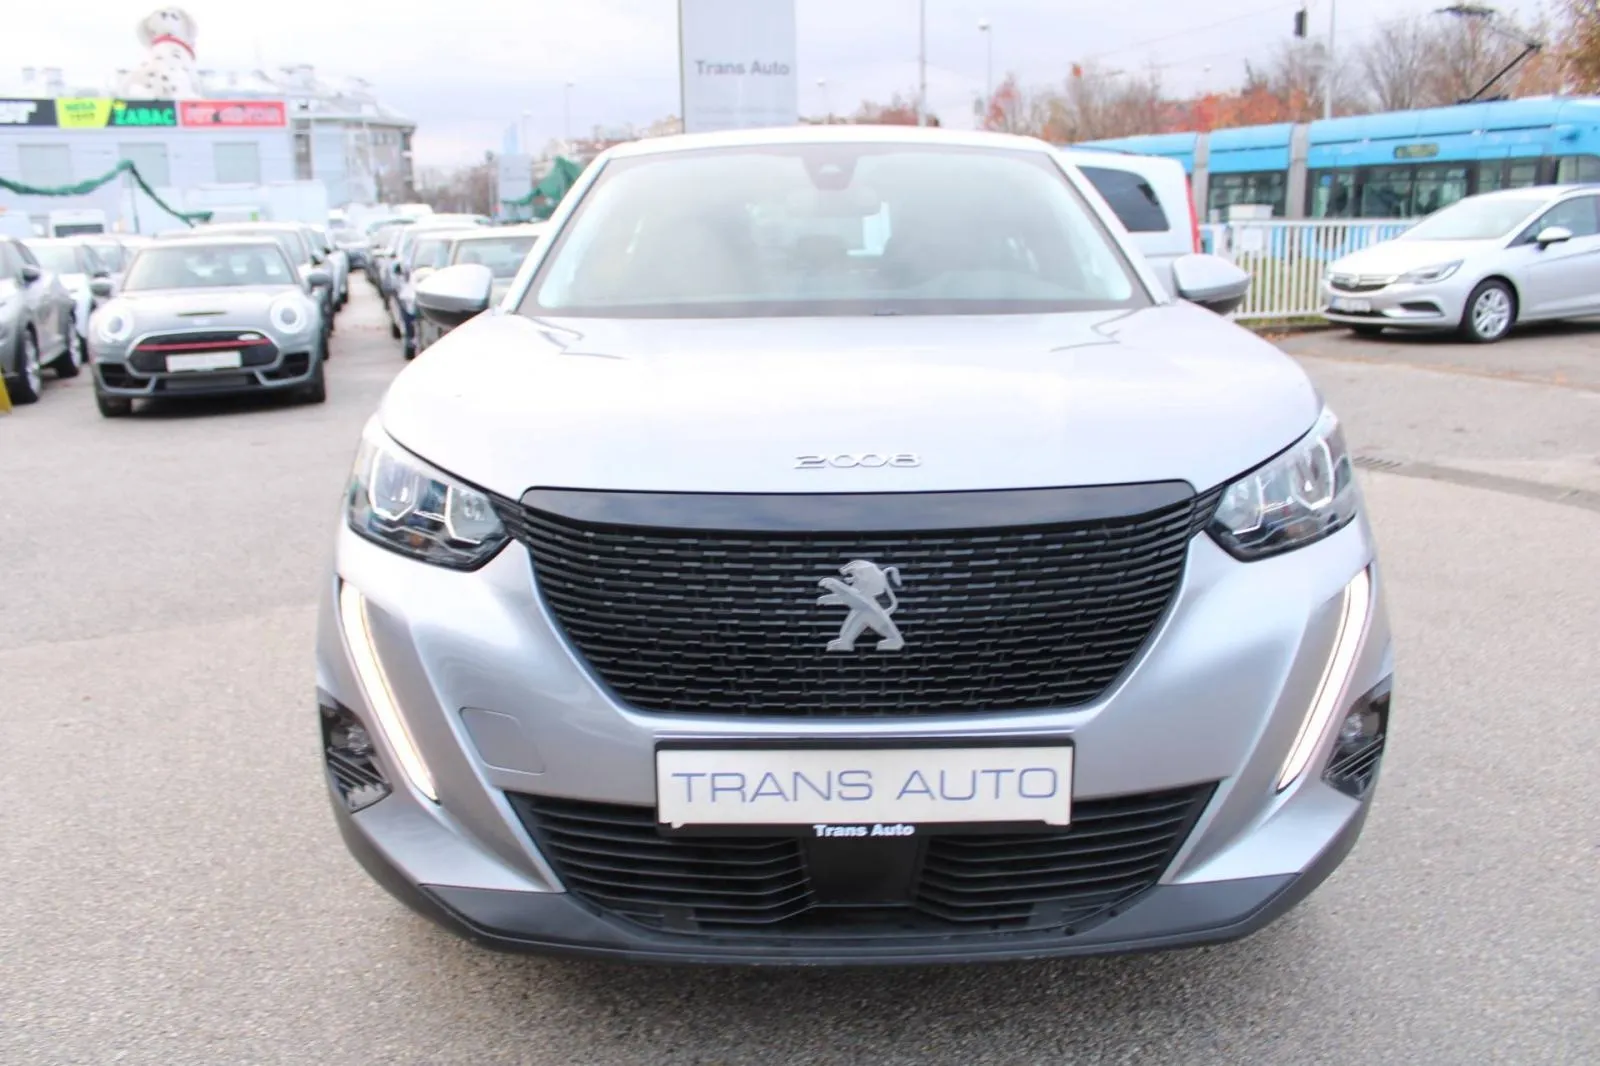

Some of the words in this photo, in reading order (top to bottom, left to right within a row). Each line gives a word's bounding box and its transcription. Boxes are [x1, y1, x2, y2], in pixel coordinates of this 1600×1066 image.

[695, 60, 746, 76] Trans
[750, 60, 790, 76] Auto
[794, 453, 923, 470] 2008
[671, 770, 875, 803] TRANS
[895, 766, 1059, 801] AUTO
[813, 823, 868, 837] Trans
[870, 823, 915, 837] Auto
